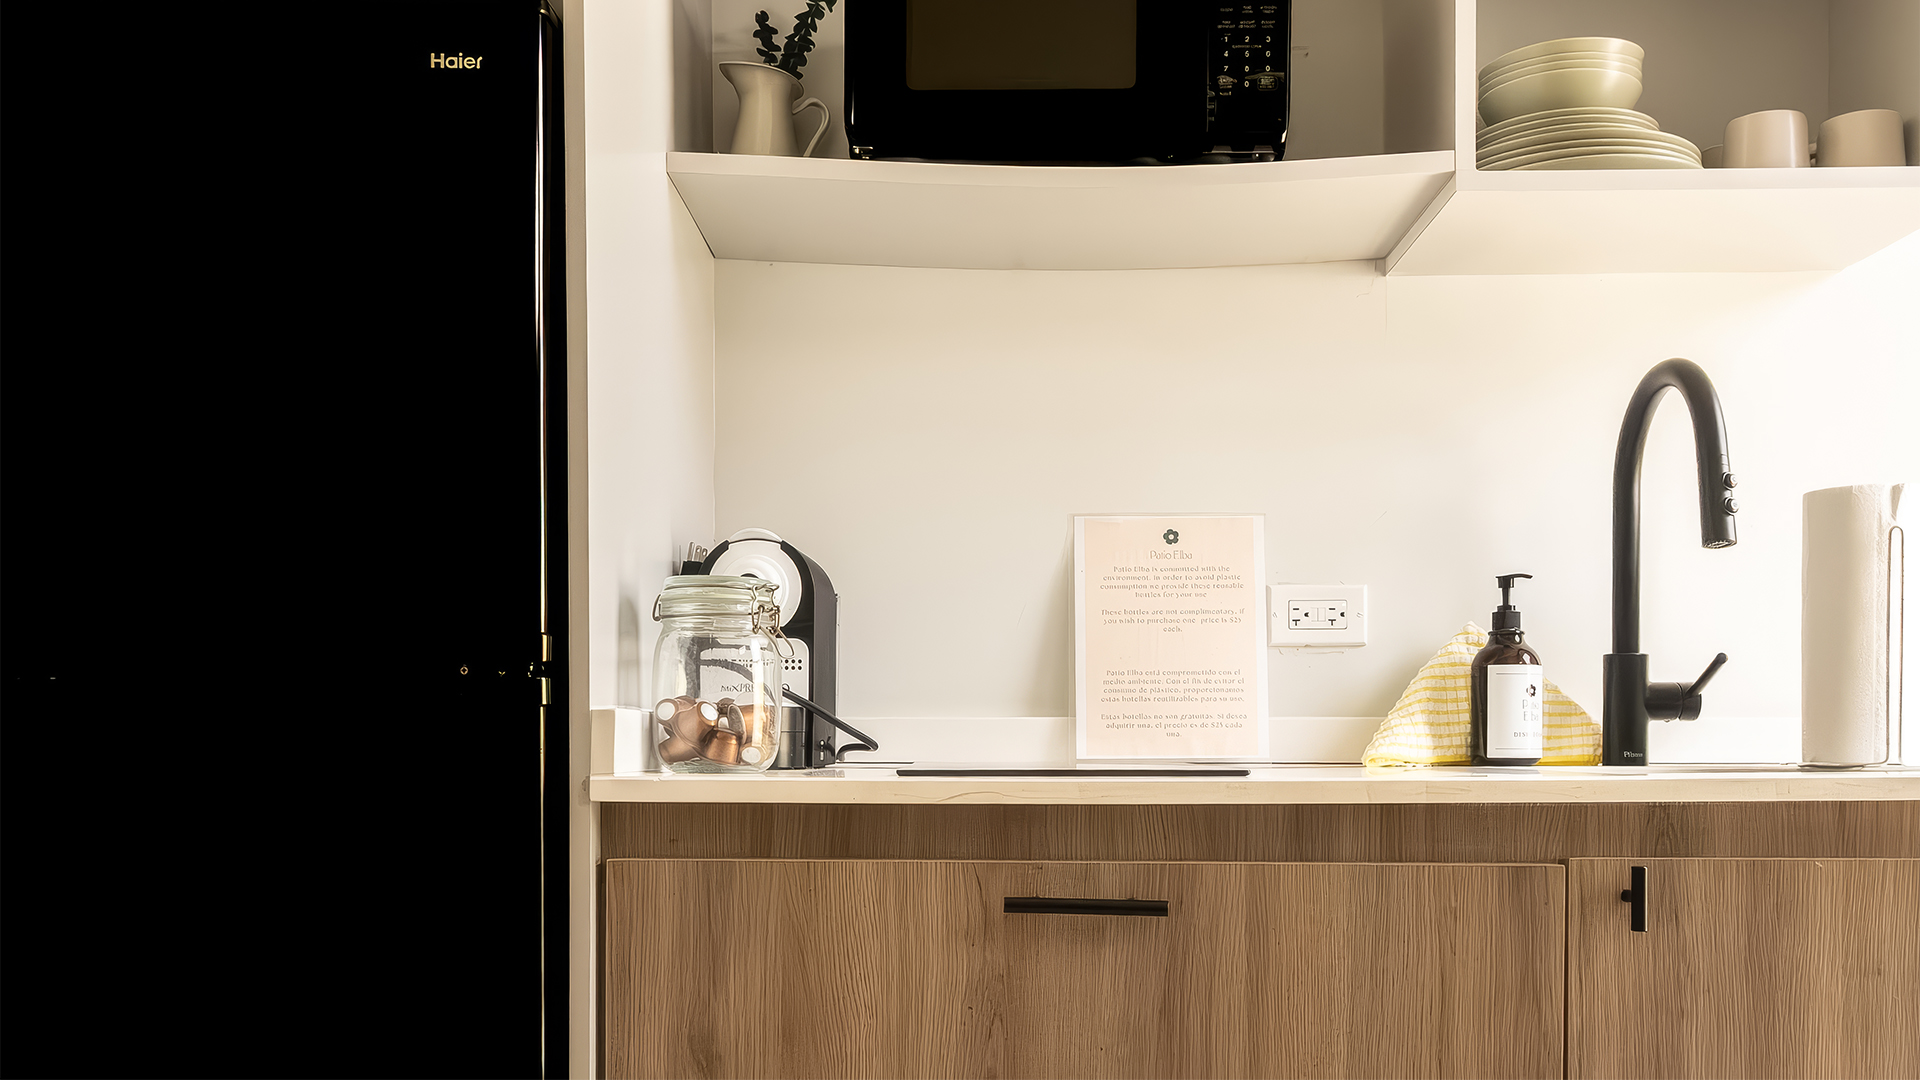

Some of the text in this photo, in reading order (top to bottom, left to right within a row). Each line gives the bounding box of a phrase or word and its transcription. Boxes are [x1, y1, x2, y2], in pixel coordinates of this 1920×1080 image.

[431, 52, 482, 69] Haier
[1150, 550, 1192, 560] Patio Elba
[1217, 574, 1240, 582] plastic
[1100, 583, 1147, 591] consumption
[1161, 583, 1189, 591] provide
[1201, 617, 1219, 625] price
[1162, 669, 1216, 677] comprometido
